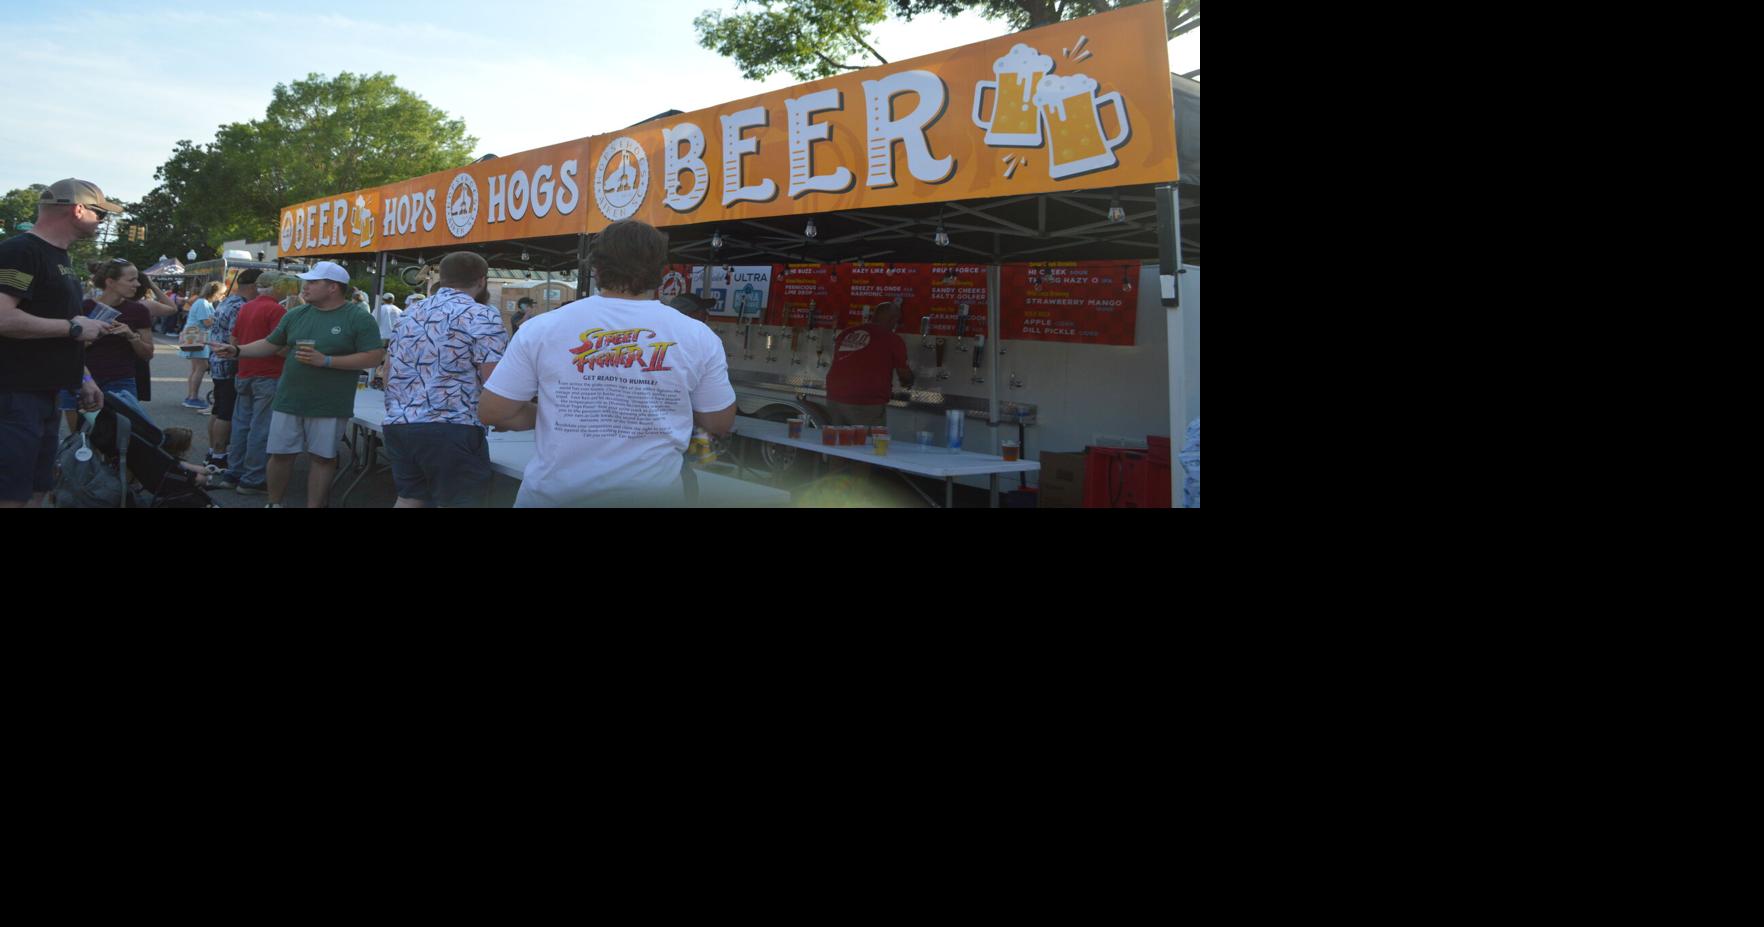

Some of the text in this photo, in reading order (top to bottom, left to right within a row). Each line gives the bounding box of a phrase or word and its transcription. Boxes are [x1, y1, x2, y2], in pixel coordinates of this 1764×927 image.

[661, 70, 957, 213] BEER
[487, 159, 579, 224] HOGS
[295, 199, 348, 250] BEER
[383, 189, 437, 236] HOPS
[734, 273, 768, 282] ULTRA
[569, 328, 656, 354] STREET
[1044, 327, 1076, 335] PICKLE
[572, 343, 648, 373] FIGHTER
